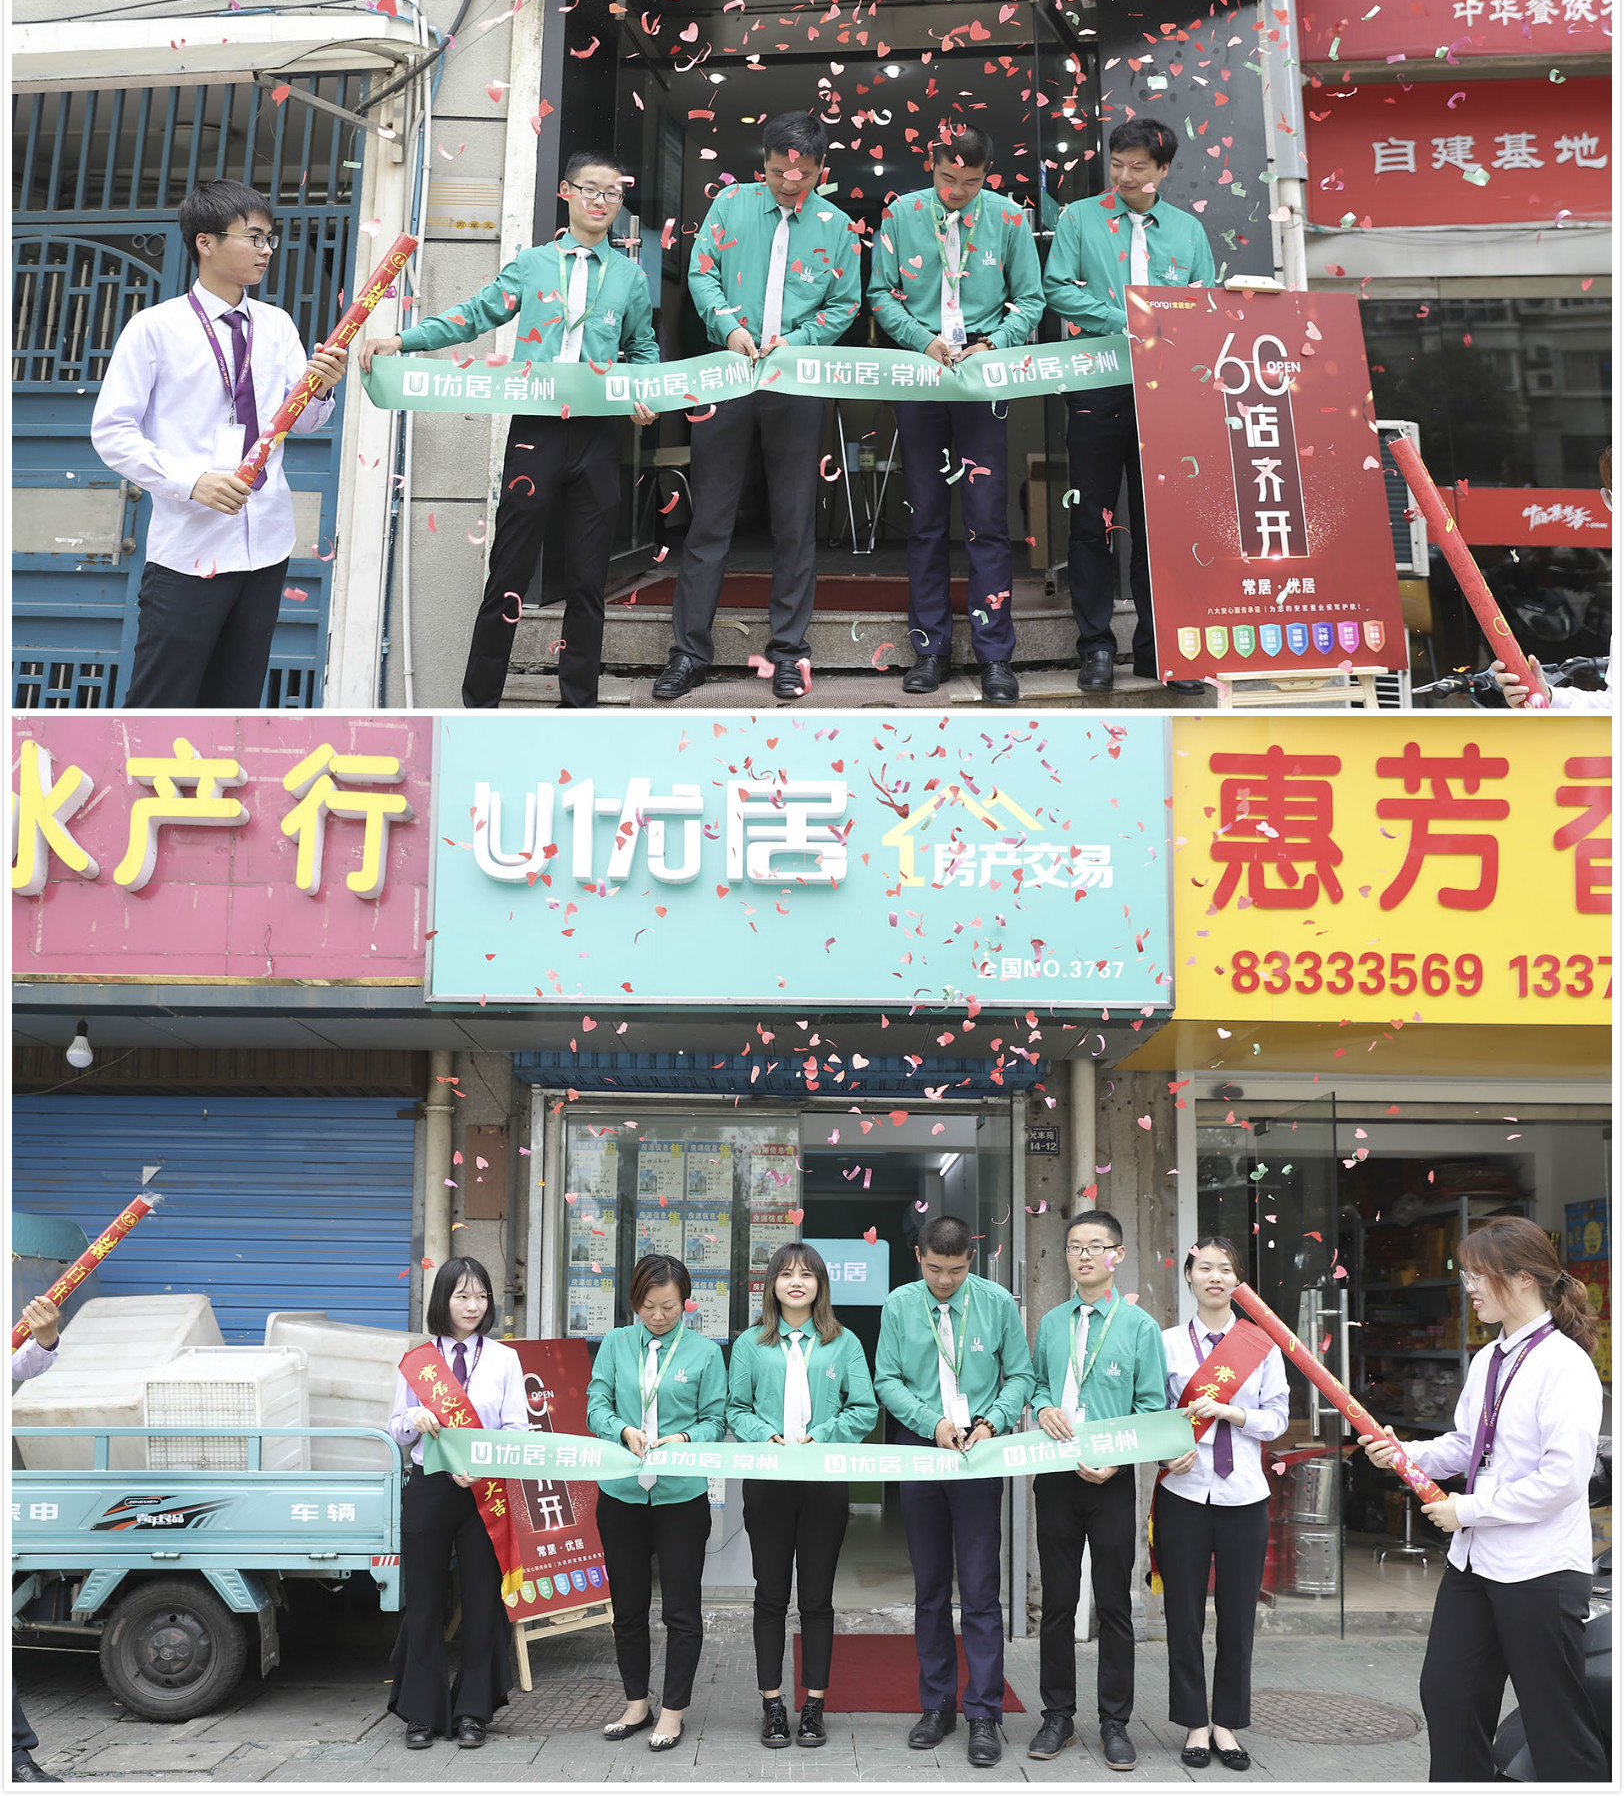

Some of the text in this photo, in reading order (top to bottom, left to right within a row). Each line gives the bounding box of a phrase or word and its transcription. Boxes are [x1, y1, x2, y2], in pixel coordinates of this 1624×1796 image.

[1371, 131, 1608, 174] 自建基地
[1266, 359, 1301, 375] OPEN
[932, 842, 1114, 890] 房产交易
[1230, 948, 1485, 997] 83333569
[1030, 1142, 1057, 1151] 14-12
[531, 1390, 555, 1400] OPEN
[290, 1502, 357, 1523] 车辆
